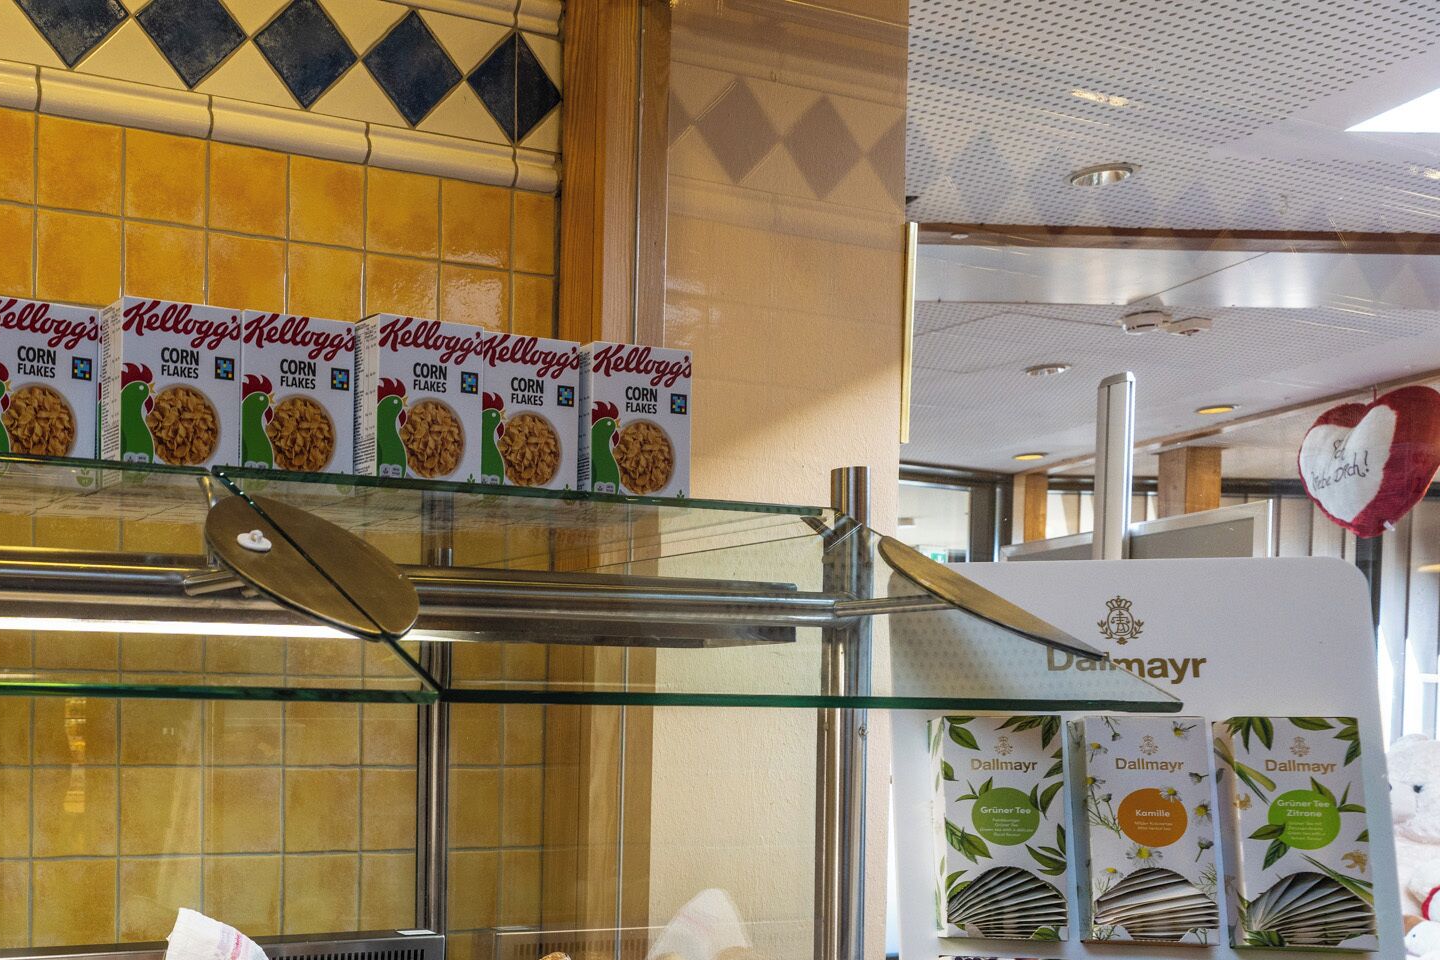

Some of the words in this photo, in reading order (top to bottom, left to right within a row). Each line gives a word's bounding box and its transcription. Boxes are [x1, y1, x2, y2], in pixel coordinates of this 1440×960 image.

[122, 300, 241, 350] Kellogg's
[243, 314, 355, 361] Kellogg's
[379, 317, 483, 365] Kellogg's
[17, 346, 56, 365] CORN
[161, 347, 199, 366] CORN
[483, 334, 580, 379] Kellogg's
[18, 363, 56, 379] FLAKES
[161, 364, 199, 379] FLAKES
[280, 358, 316, 377] CORN
[413, 362, 447, 381] CORN
[593, 344, 691, 388] Kellogg's
[280, 375, 316, 390] FLAKES
[413, 379, 447, 393] FLAKES
[510, 376, 544, 395] CORN
[511, 393, 544, 406] FLAKES
[625, 386, 658, 402] CORN
[625, 401, 657, 415] FLAKES
[970, 758, 1038, 773] Dallmayr
[1115, 757, 1184, 773] Dallmayr
[1265, 759, 1337, 775] Dallmayr
[980, 806, 1014, 814] Grüner
[1015, 806, 1031, 814] Tee
[1313, 800, 1330, 808] Tee
[1135, 809, 1170, 817] Kamille
[1286, 809, 1322, 817] Zitrone
